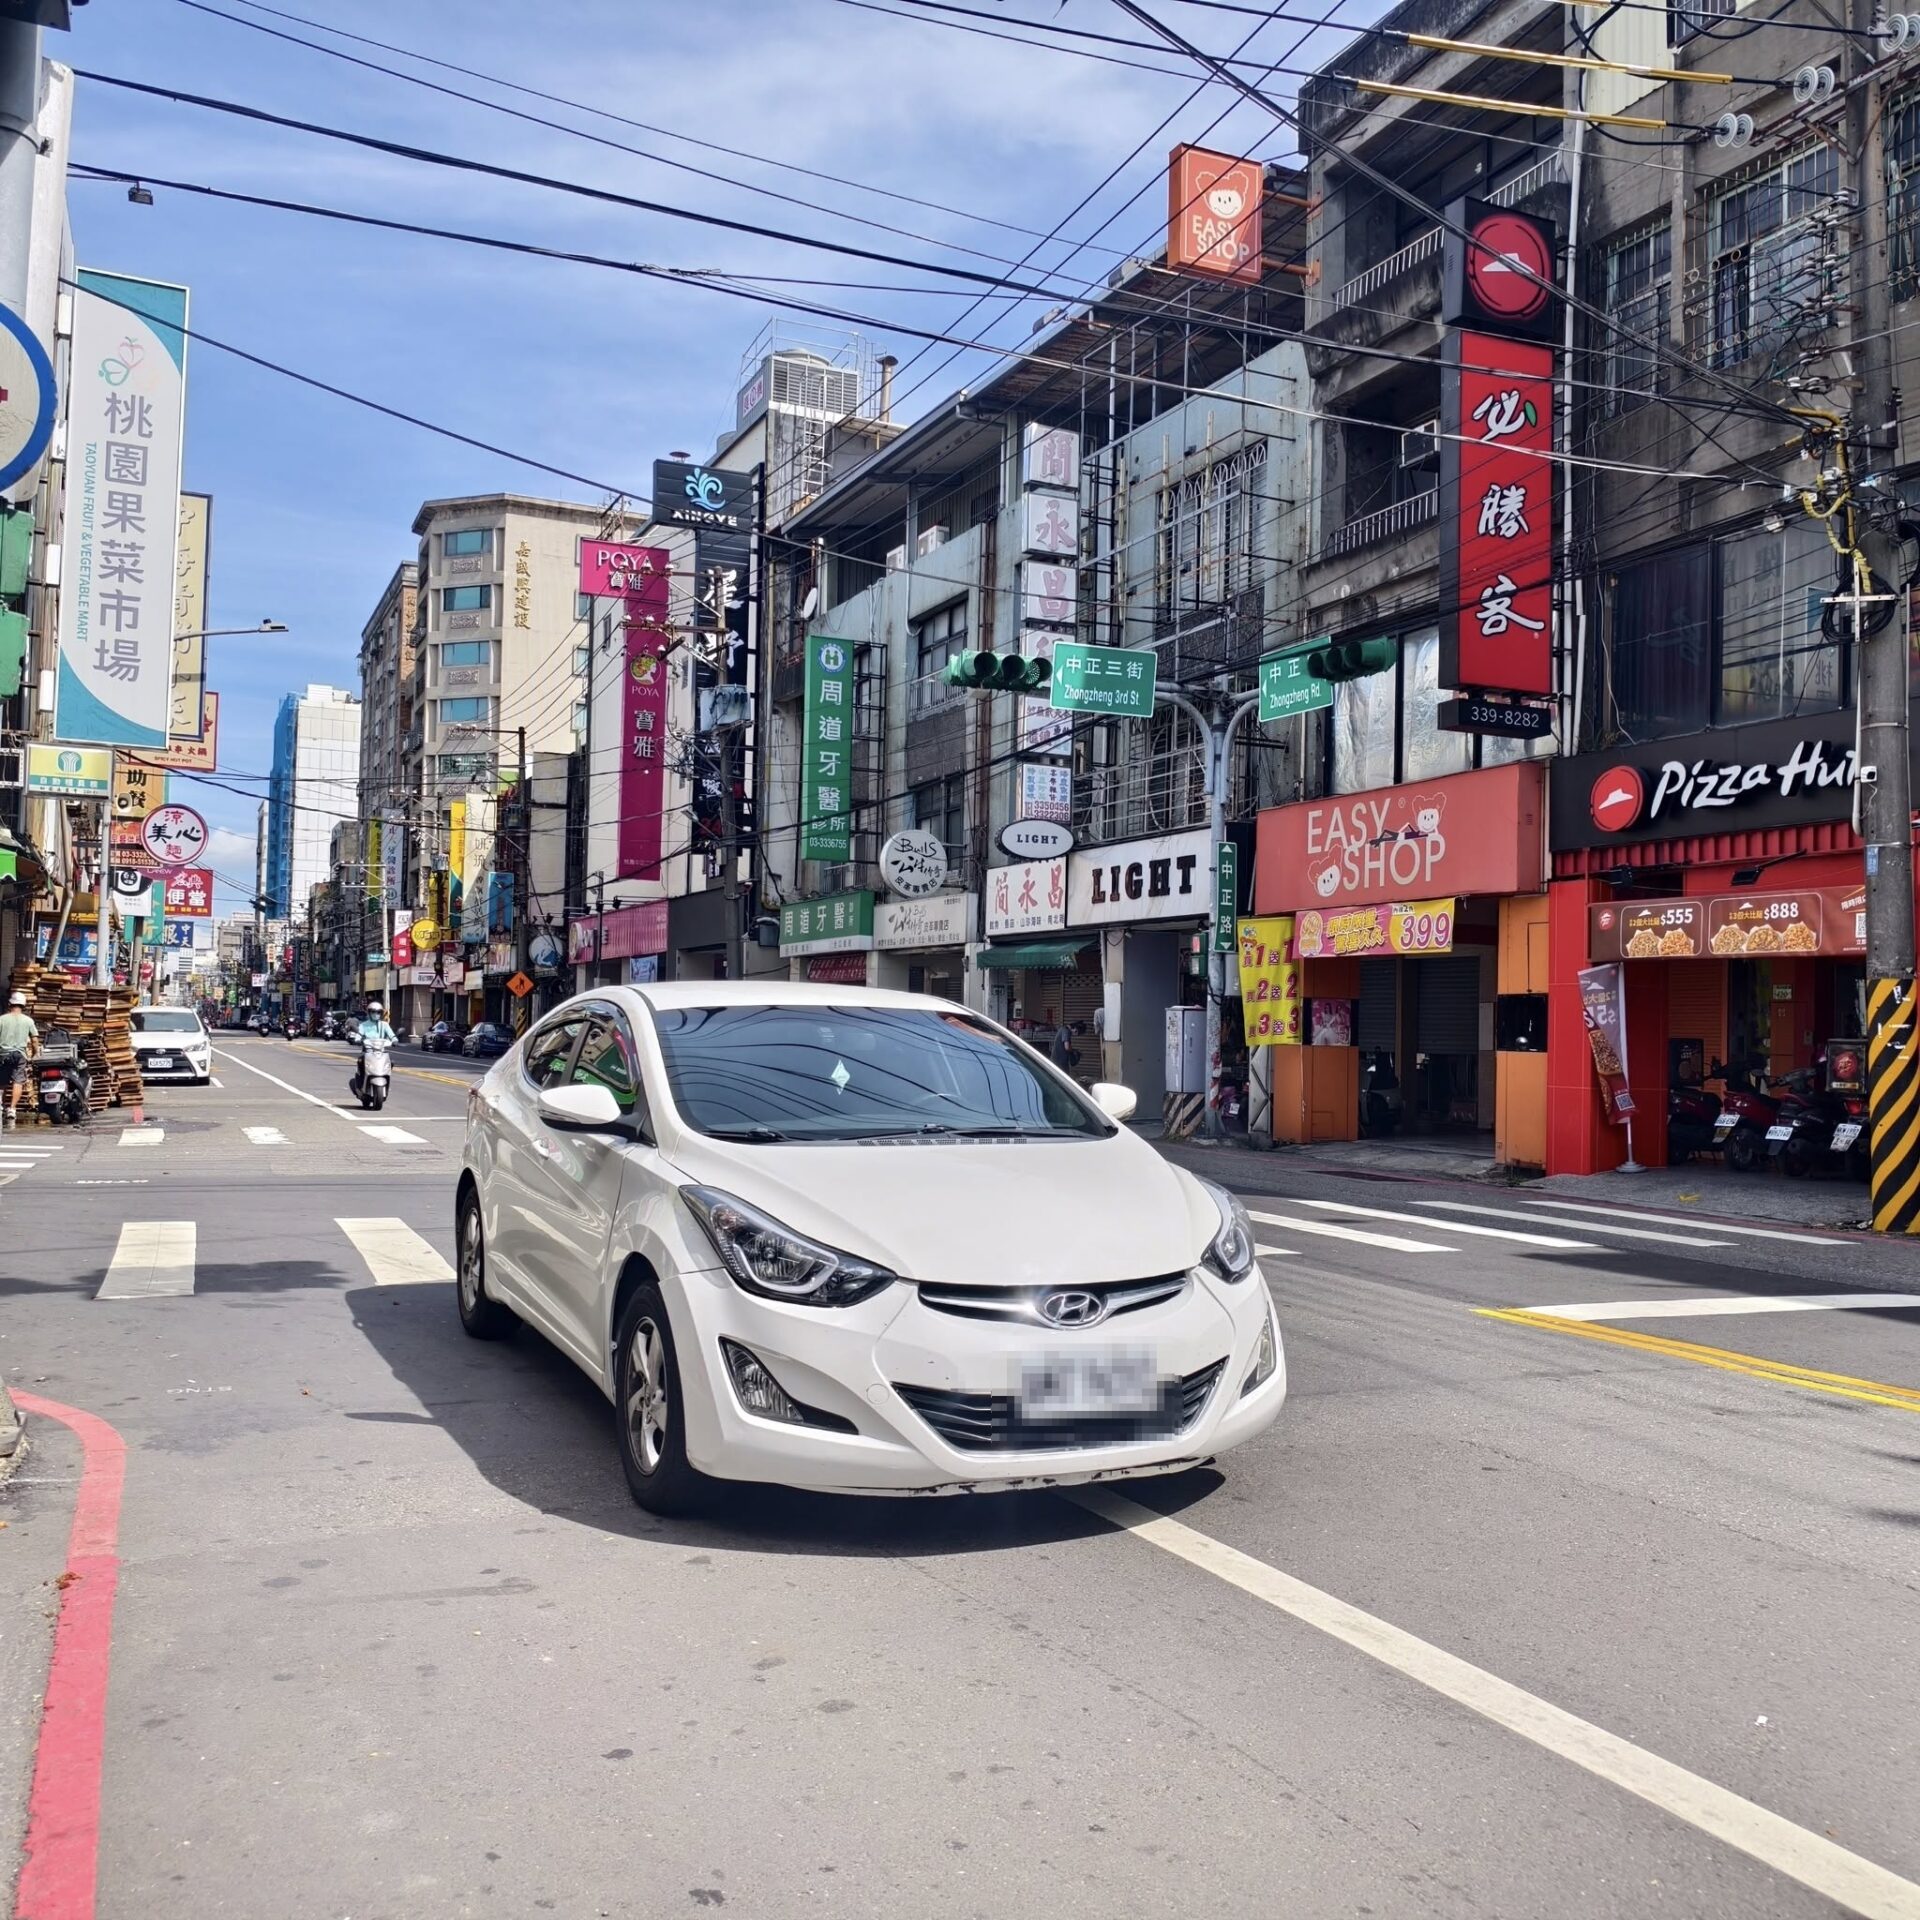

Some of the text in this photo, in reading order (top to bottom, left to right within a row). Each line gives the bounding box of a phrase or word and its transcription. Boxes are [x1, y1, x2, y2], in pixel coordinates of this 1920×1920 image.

[1192, 215, 1238, 242] EASY
[1197, 235, 1249, 261] SHOP
[1473, 389, 1544, 636] 必勝客
[76, 442, 97, 642] TAOYUAN FRUIT & VEGETABLE MART
[92, 391, 153, 683] 桃園果菜市場
[1036, 434, 1076, 662] 簡永昌
[598, 549, 653, 572] POYA
[1066, 654, 1144, 680] 中正三街
[1269, 657, 1300, 685] 中正
[632, 685, 659, 697] POYA
[1064, 684, 1113, 708] Zhongzheng
[1115, 689, 1129, 705] 3rd
[1269, 687, 1310, 709] Zhongzheng
[1471, 707, 1540, 729] 339-8282
[633, 710, 655, 758] 寶雅
[818, 679, 842, 812] 周道牙醫
[168, 745, 208, 756] 串火鍋
[1650, 759, 1771, 819] Pizza
[148, 823, 202, 843] 美心
[811, 814, 846, 832] 診所
[1308, 798, 1391, 855] EASY
[809, 836, 847, 849] 03-3336755
[1017, 834, 1058, 845] LIGHT
[1342, 834, 1446, 891] SHOP
[1091, 855, 1196, 904] LIGHT
[167, 889, 207, 906] 便當
[1220, 860, 1233, 934] 中正路
[785, 902, 844, 936] 周道牙醫
[1660, 908, 1693, 926] $555
[1764, 902, 1799, 920] $888
[1400, 911, 1450, 949] 399
